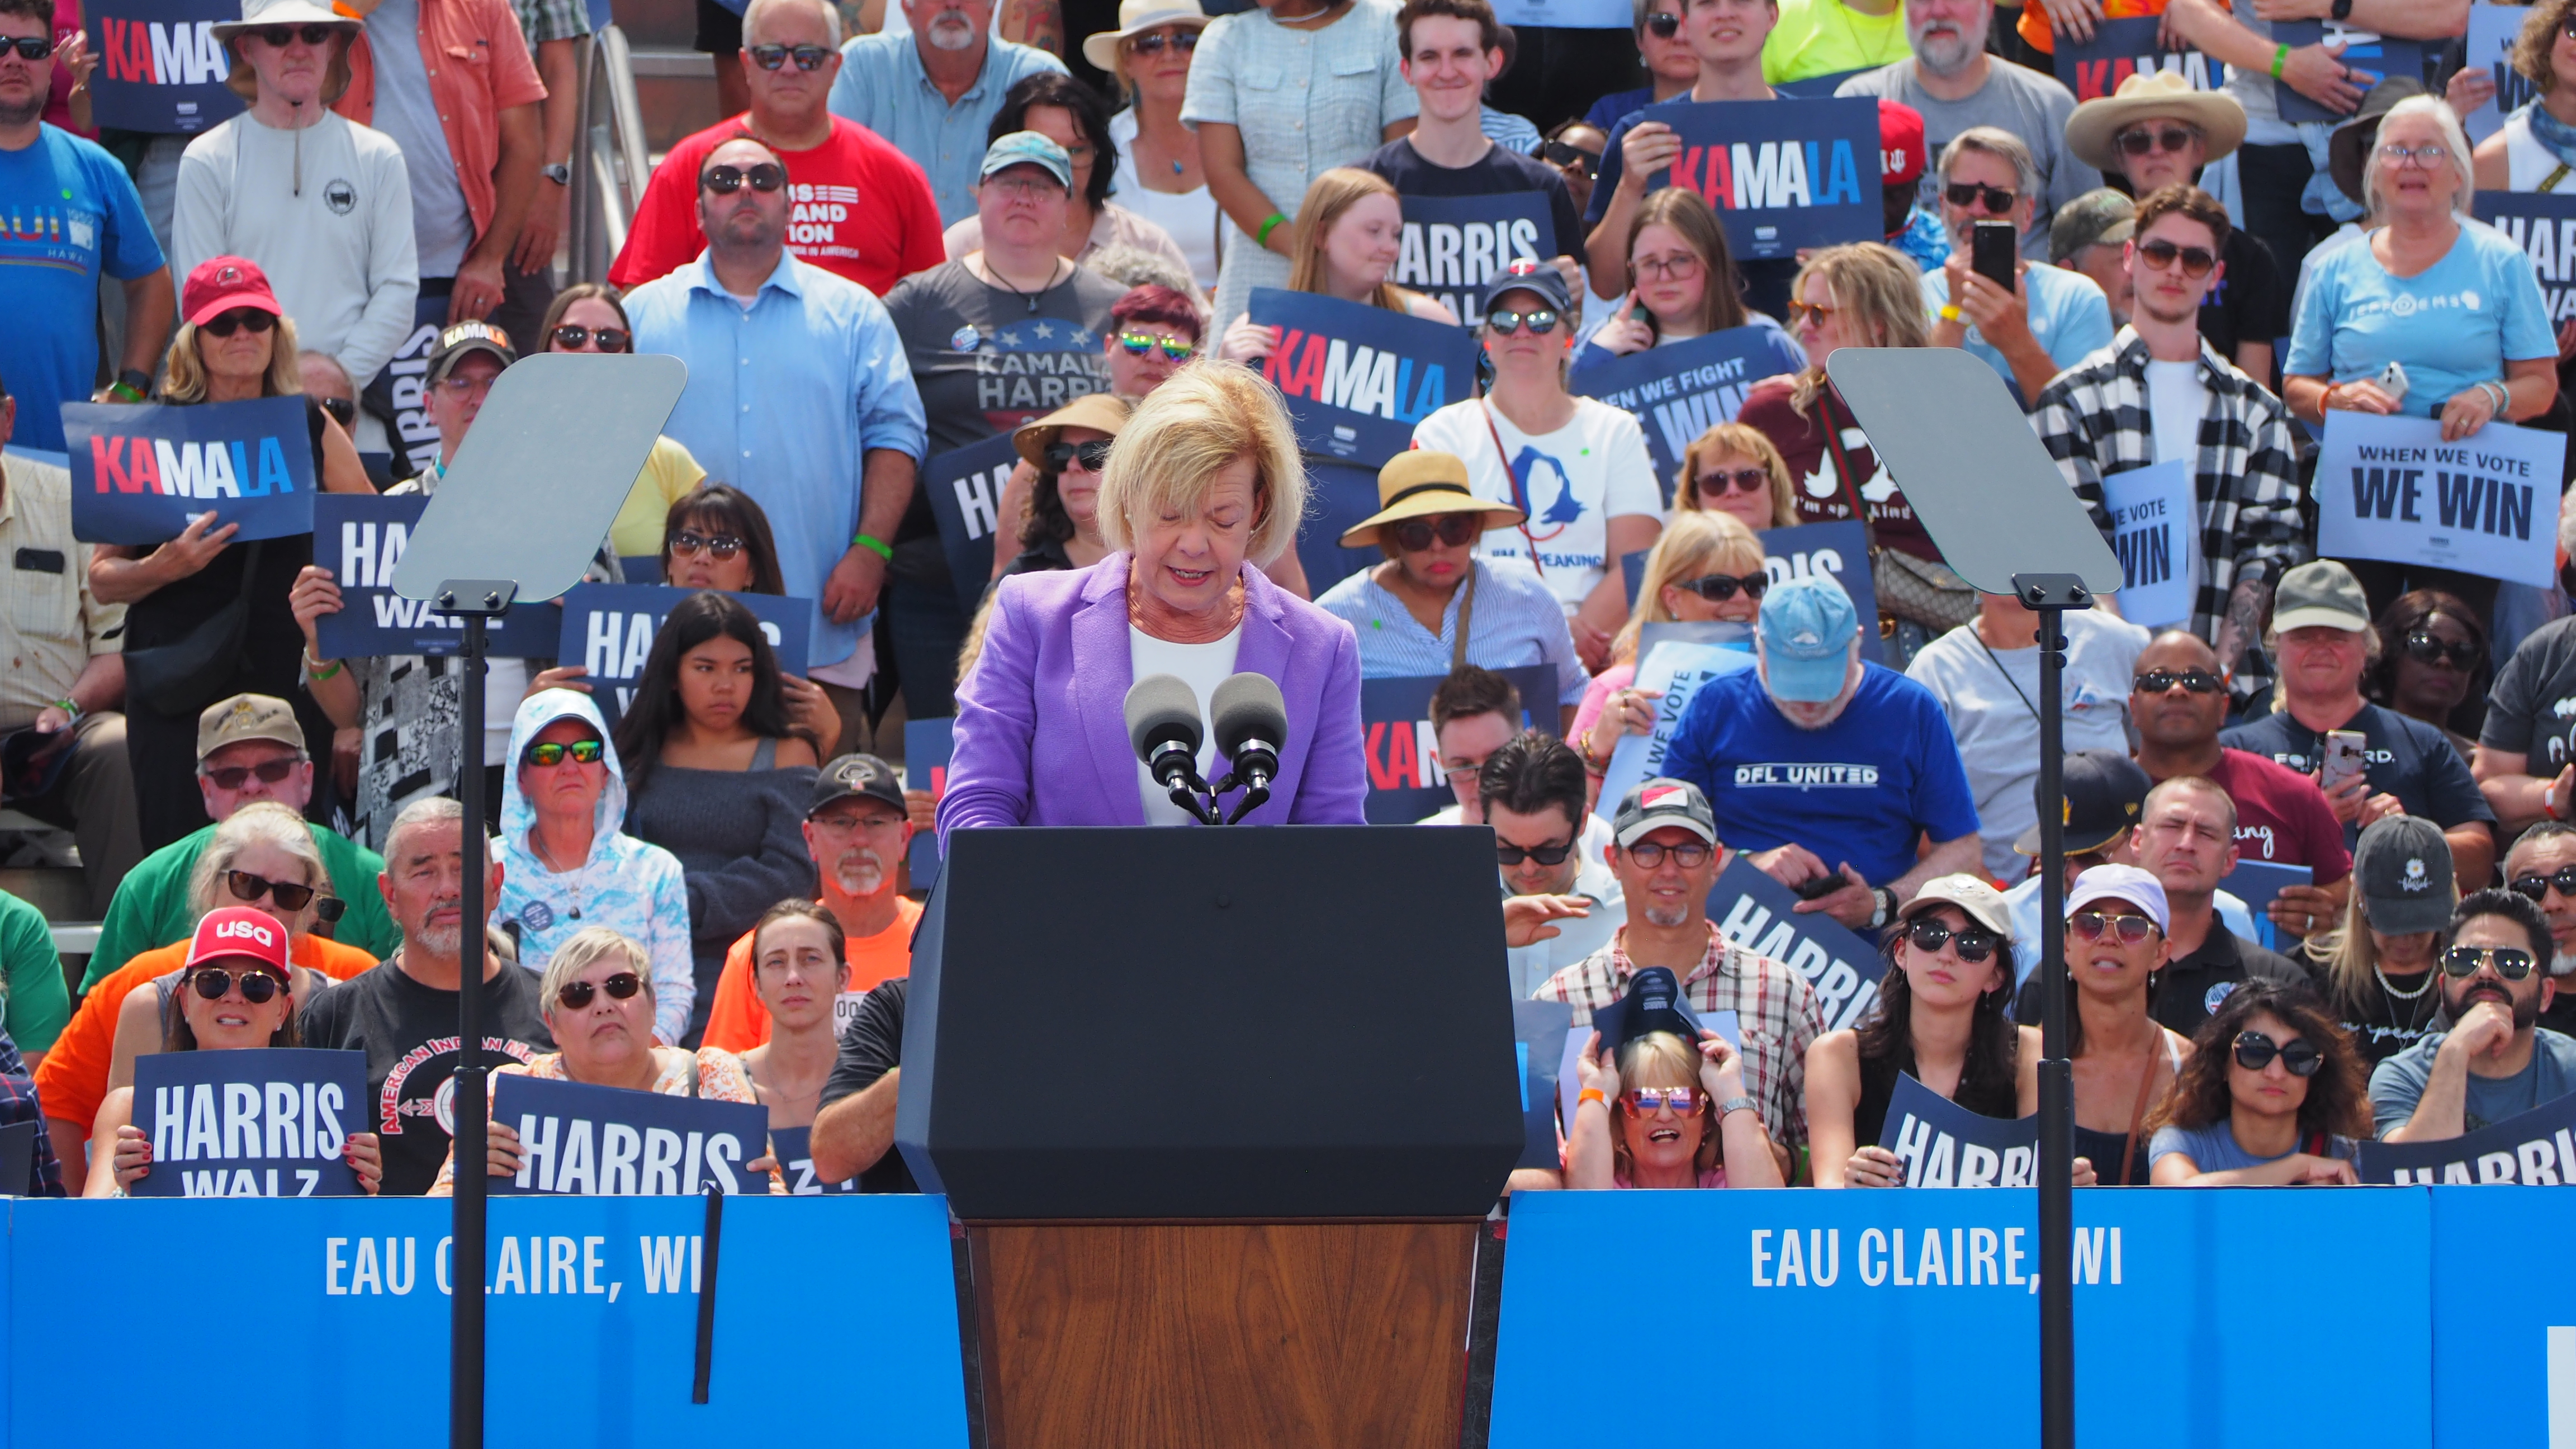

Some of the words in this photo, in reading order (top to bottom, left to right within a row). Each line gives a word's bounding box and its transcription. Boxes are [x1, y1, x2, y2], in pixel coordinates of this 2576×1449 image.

[1669, 140, 1861, 210] KAMALA
[1391, 219, 1540, 286] ARRIS
[444, 323, 507, 349] KAMALA
[1263, 324, 1446, 426] KAMALA
[1639, 376, 1677, 403] WE
[1678, 357, 1746, 392] FIGHT
[91, 434, 293, 499] KAMALA
[2357, 445, 2427, 465] WHEN
[2433, 447, 2469, 466] WE
[2475, 452, 2531, 478] VOTE
[2130, 497, 2166, 522] VOTE
[2351, 467, 2423, 524] WE
[2435, 471, 2534, 542] WIN
[1660, 671, 1690, 723] VOTE
[1735, 766, 1777, 784] DFL
[1788, 766, 1878, 785] UNITED
[216, 920, 272, 948] usa
[153, 1082, 345, 1162] HARRIS
[380, 1044, 434, 1135] AMERICAN
[515, 1113, 742, 1195] HARRIS
[326, 1237, 416, 1296] EAU
[434, 1235, 623, 1304] CAIRE,
[640, 1235, 702, 1294] WI
[1751, 1228, 1839, 1287] EAU
[1858, 1227, 2040, 1295] CLAIRE,
[2072, 1227, 2122, 1285] WI
